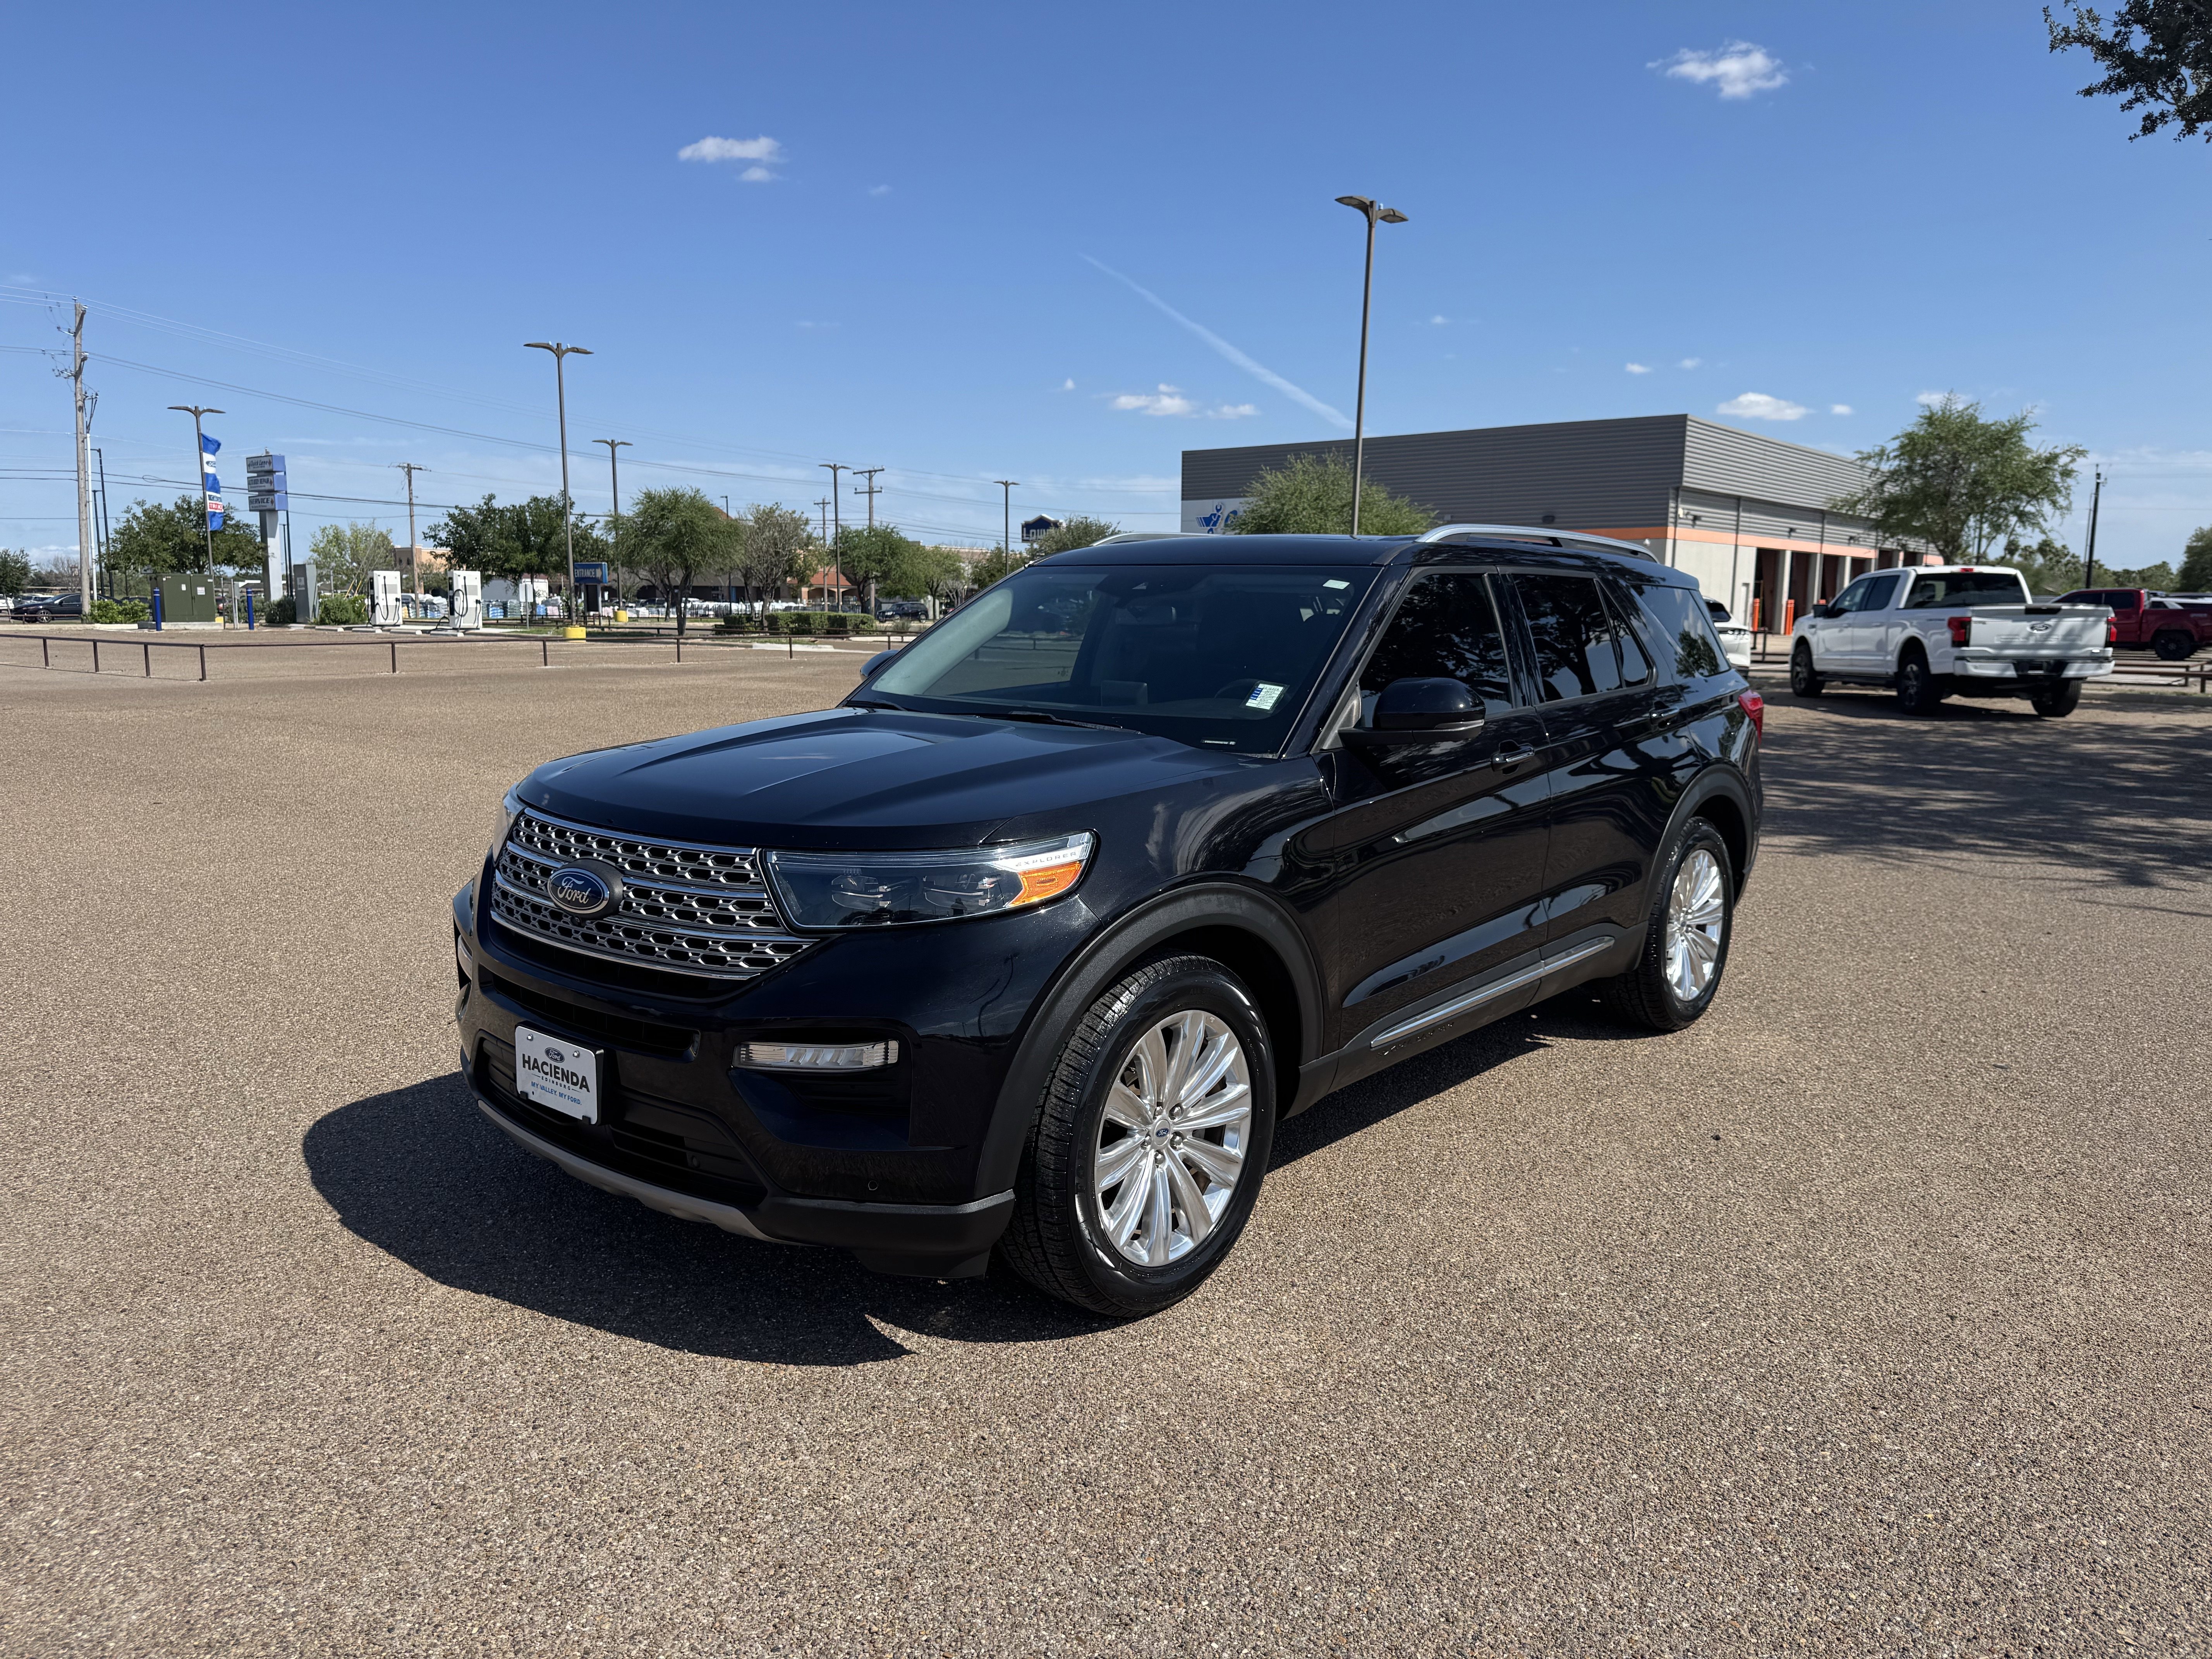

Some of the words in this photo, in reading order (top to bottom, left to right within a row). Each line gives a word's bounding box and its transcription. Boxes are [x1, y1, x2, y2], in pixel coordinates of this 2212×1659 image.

[574, 568, 595, 578] ENTRANCE
[1015, 852, 1077, 867] EXPLORER
[557, 876, 591, 904] Ford
[549, 1049, 561, 1061] Ford
[522, 1053, 590, 1093] HACIENDA
[541, 1076, 570, 1091] EDINBURG
[567, 1095, 582, 1106] FORD.
